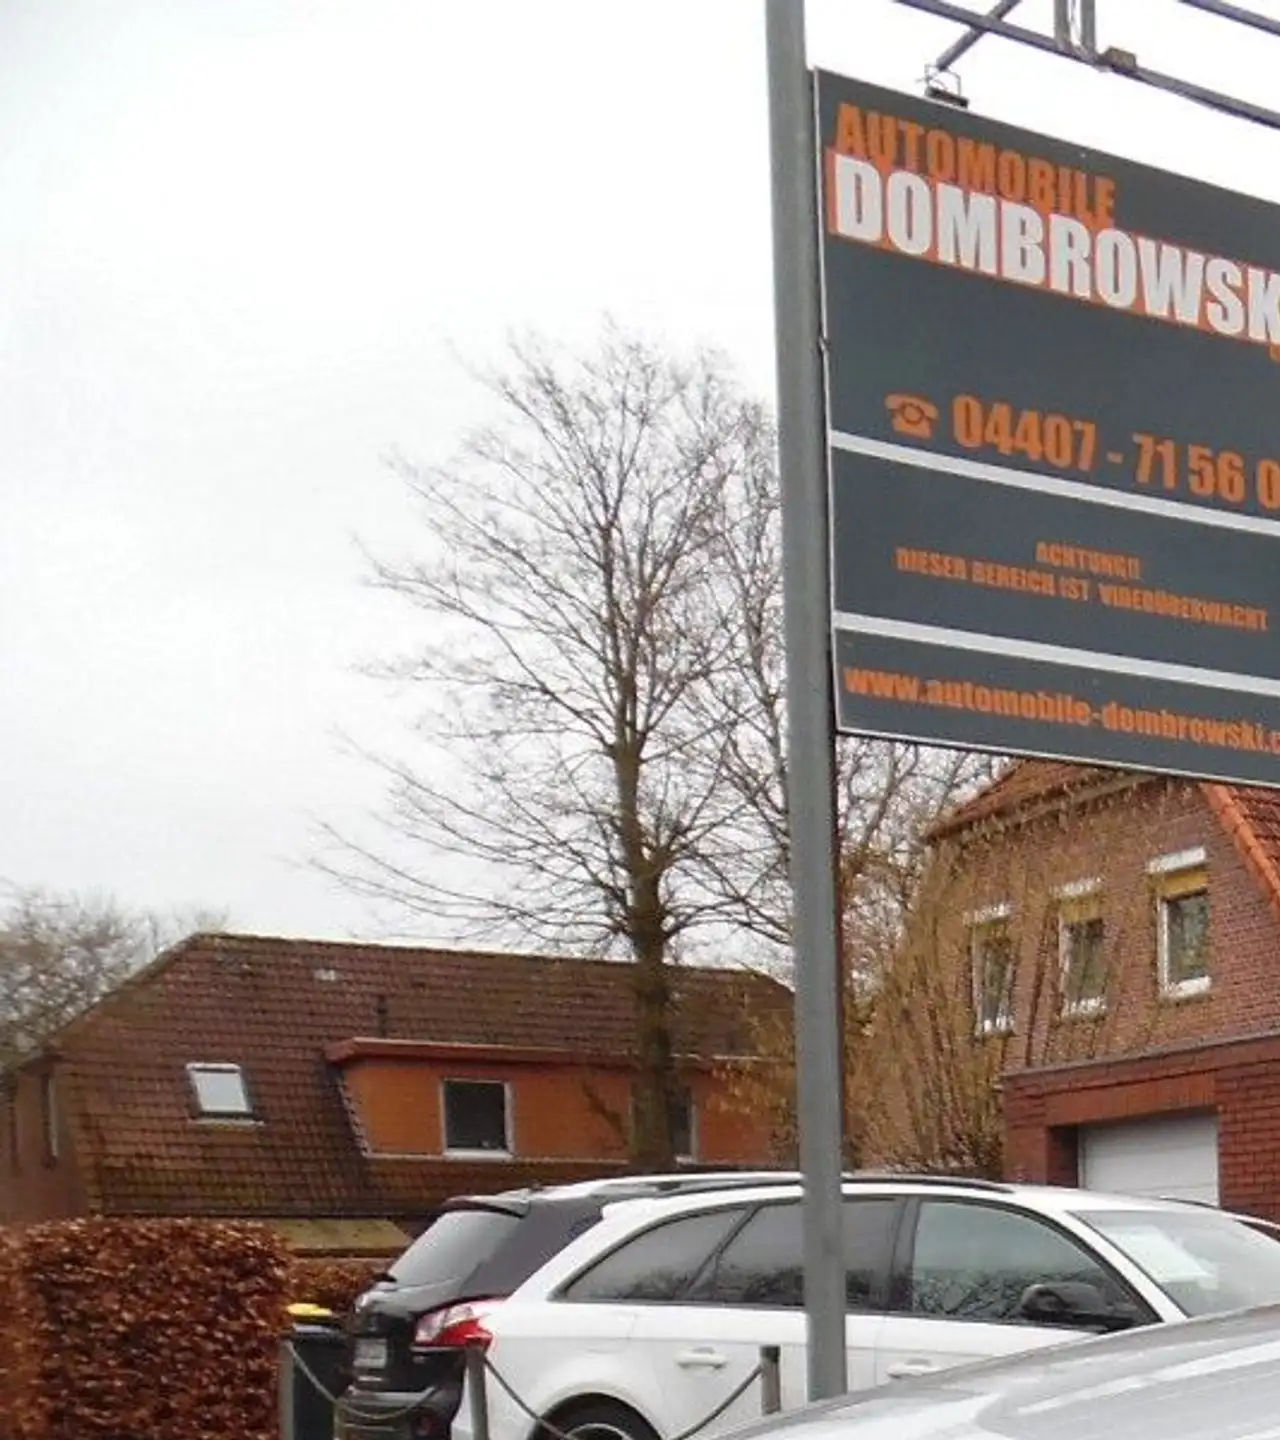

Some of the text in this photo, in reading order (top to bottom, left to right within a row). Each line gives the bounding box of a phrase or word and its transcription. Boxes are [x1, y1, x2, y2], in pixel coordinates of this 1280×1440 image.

[837, 103, 1116, 229] AUTOMOBILE
[951, 394, 1096, 471] 04407
[1132, 432, 1178, 490] 71
[1187, 444, 1246, 503] 56
[896, 548, 967, 580] DIESER
[972, 561, 1055, 596] BEREICH
[1059, 576, 1088, 601] IST
